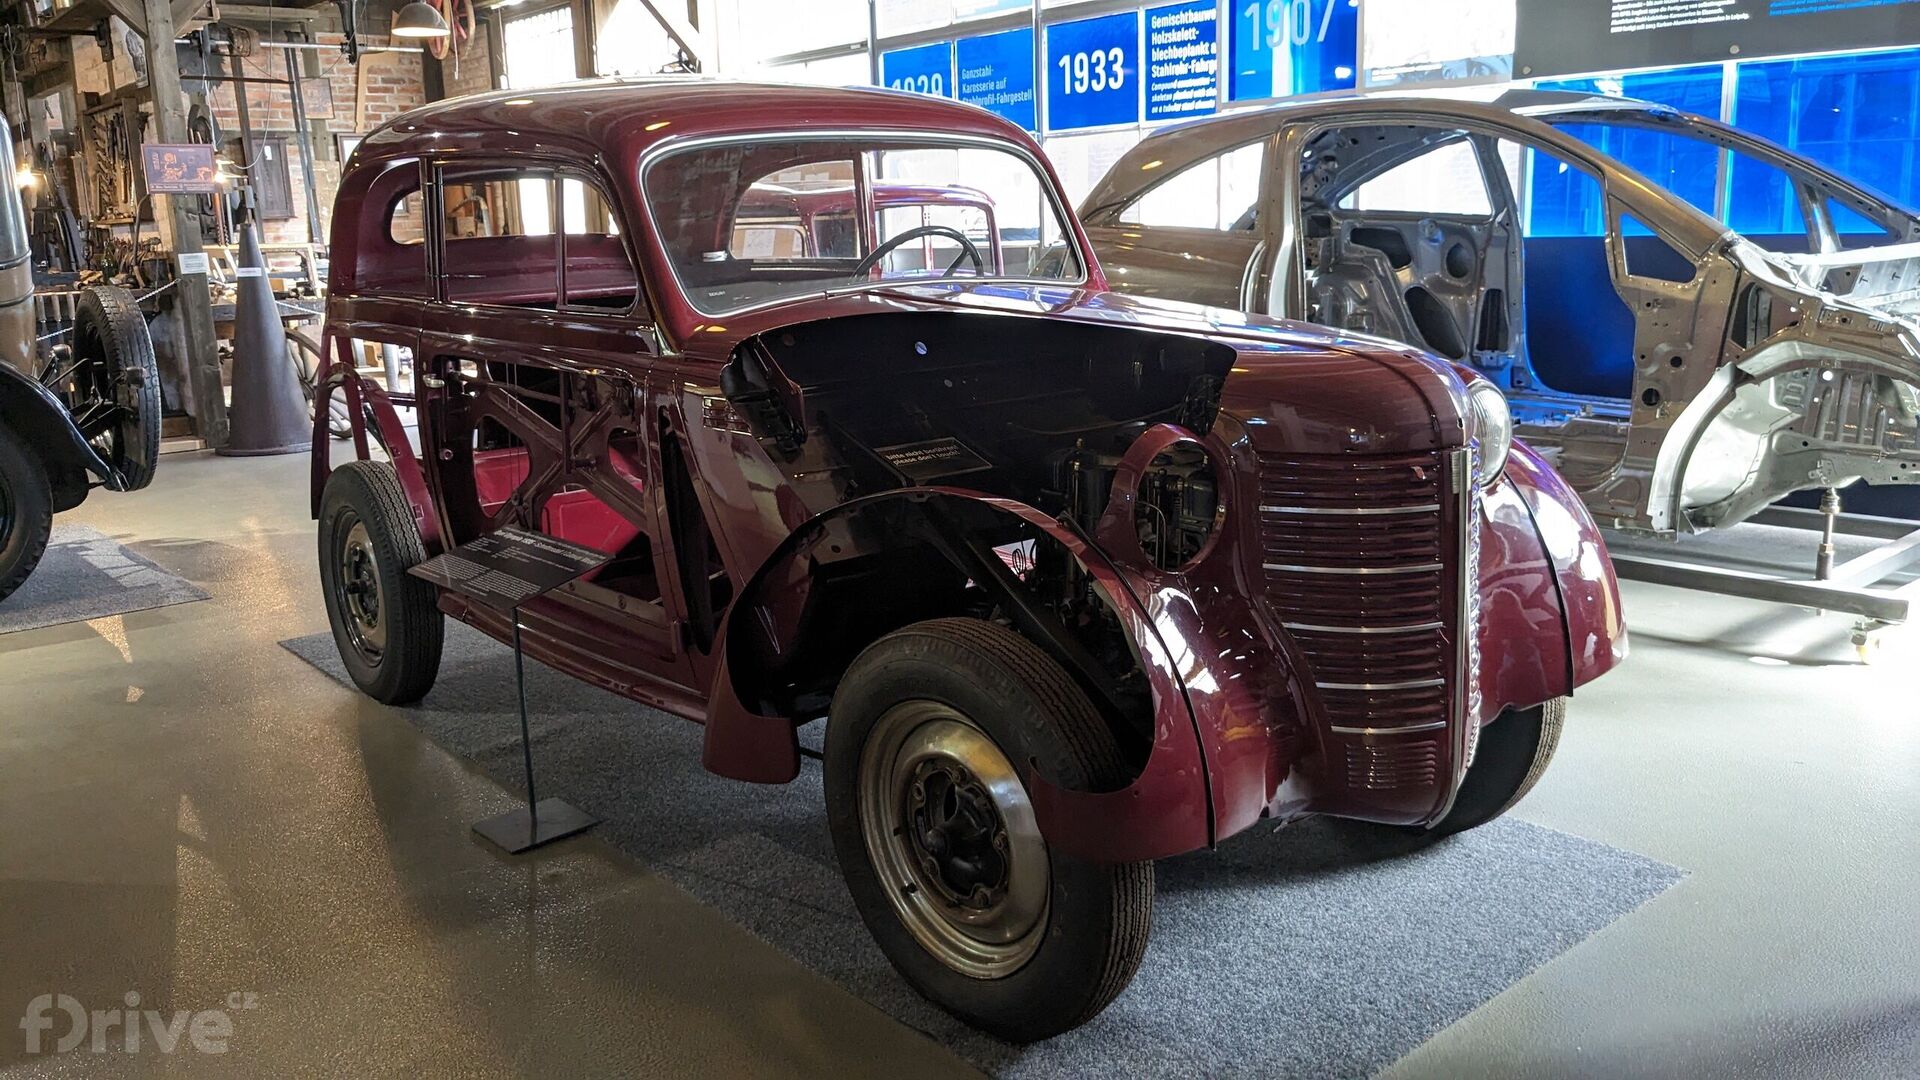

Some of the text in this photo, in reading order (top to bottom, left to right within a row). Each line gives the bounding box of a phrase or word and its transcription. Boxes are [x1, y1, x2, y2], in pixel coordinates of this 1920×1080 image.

[1151, 26, 1200, 46] Holzskelett-
[1151, 41, 1209, 61] blechbeplankt
[962, 65, 994, 80] Ganzstahl-
[1058, 47, 1124, 95] 1933
[962, 77, 1007, 94] Karosserie auf
